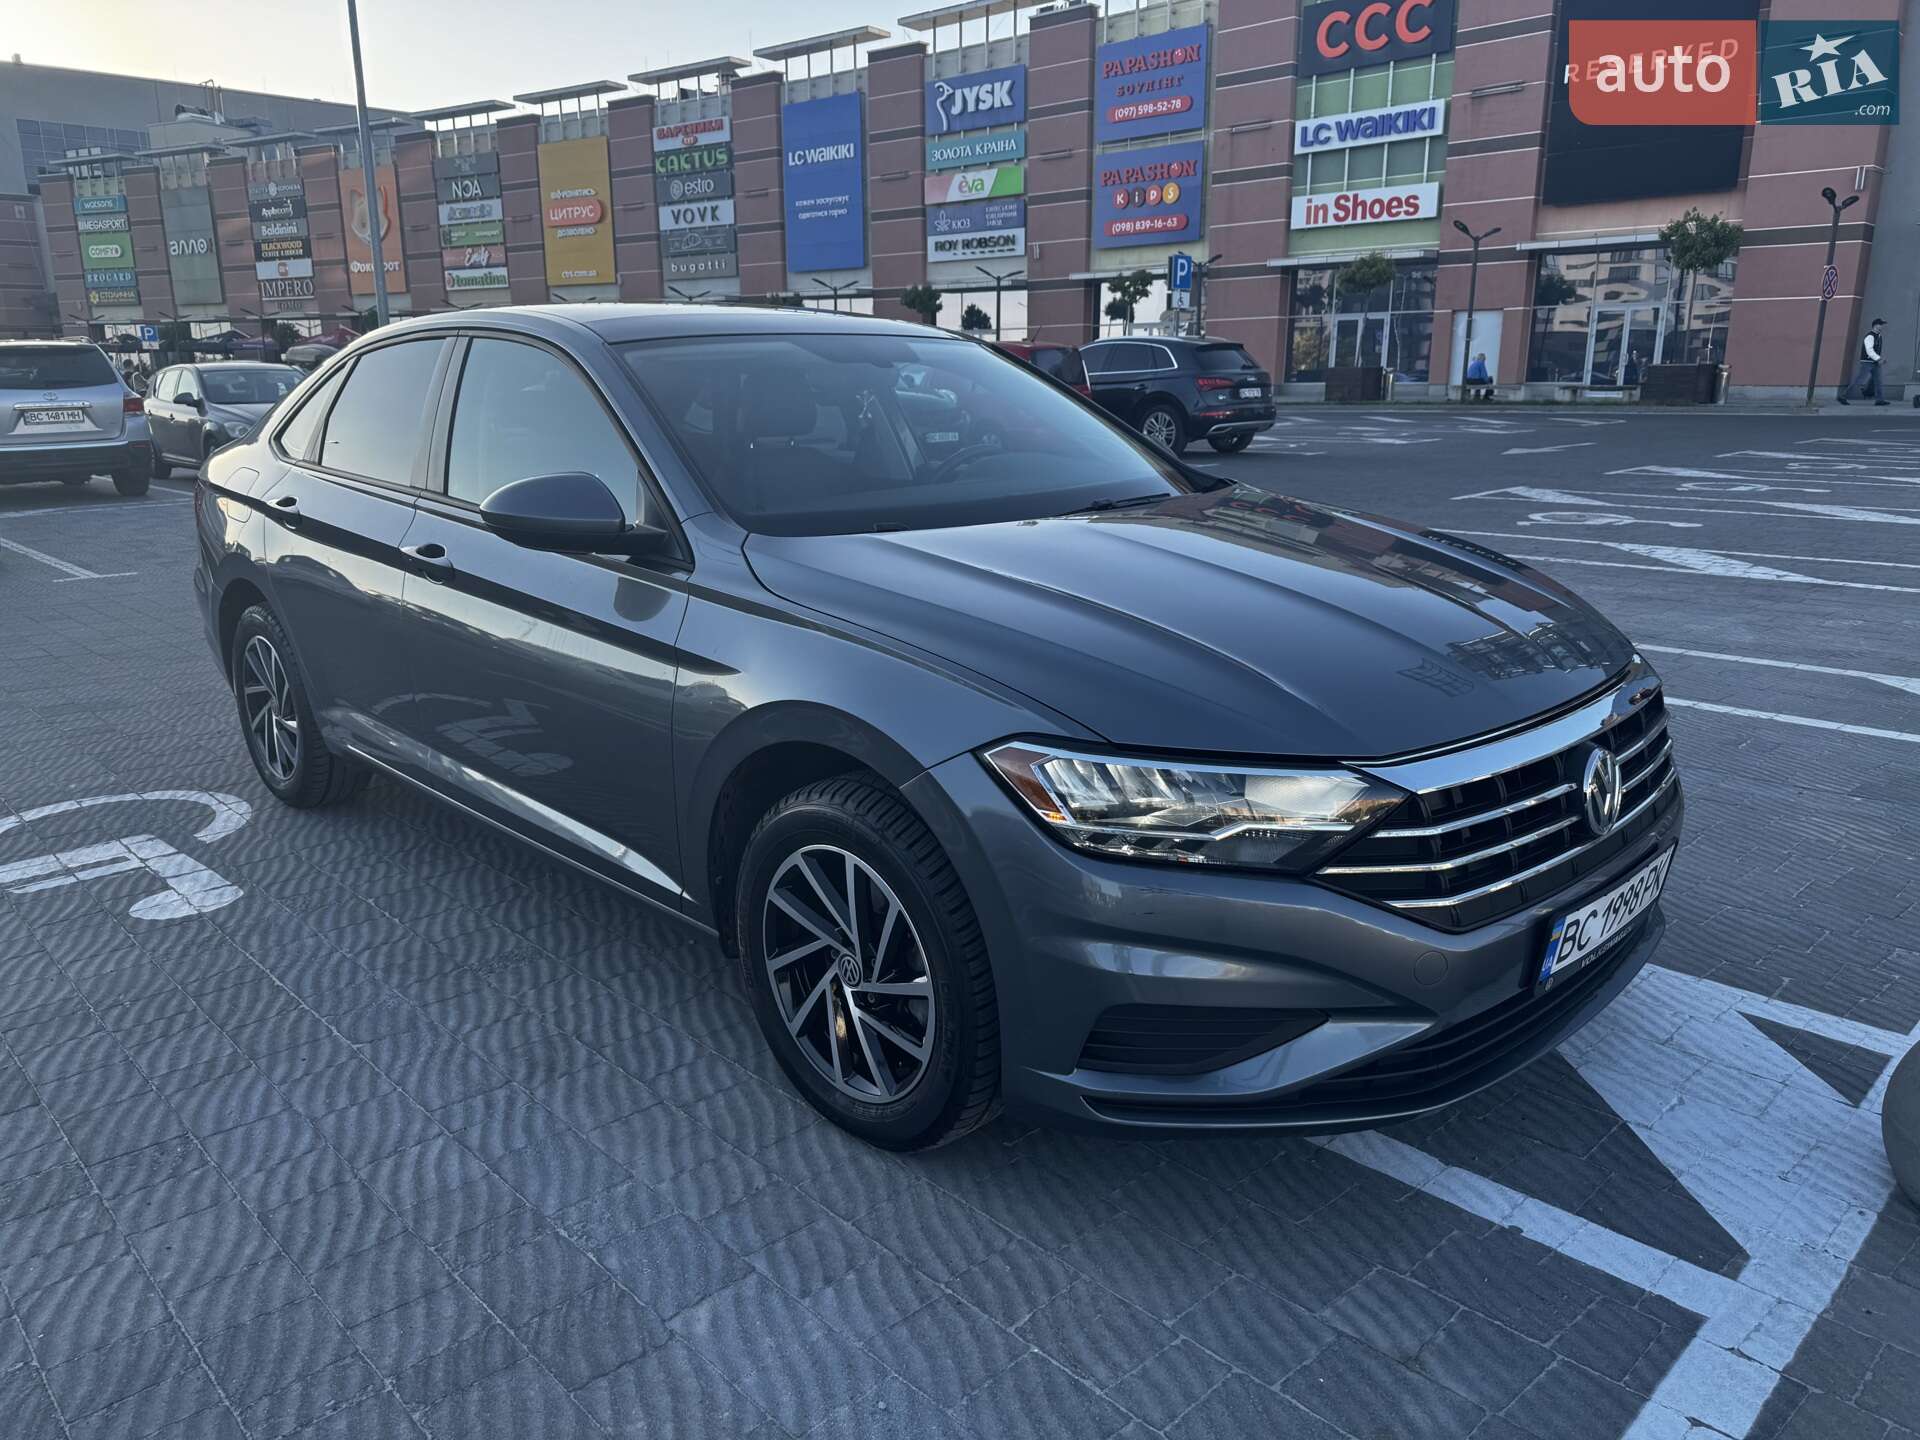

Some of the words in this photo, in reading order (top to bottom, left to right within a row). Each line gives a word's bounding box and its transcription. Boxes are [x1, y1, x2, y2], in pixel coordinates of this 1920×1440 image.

[1316, 0, 1432, 58] CCC
[1103, 44, 1201, 79] PAPASHON
[951, 79, 1014, 115] JYSK
[1115, 107, 1136, 121] (097)
[1300, 123, 1332, 148] LC
[788, 151, 805, 167] LC
[931, 145, 972, 162] ЗОЛОТА
[1101, 159, 1198, 188] PAPASHON
[550, 205, 595, 221] ЦИТРУС
[671, 204, 720, 225] VOVK
[1305, 198, 1329, 226] in
[1333, 193, 1421, 223] Shoes
[935, 241, 958, 252] ROY
[961, 234, 1016, 250] ROBSON
[671, 259, 726, 273] bugatti
[1176, 259, 1188, 285] P
[87, 273, 131, 282] BROCARD
[261, 280, 313, 297] IMPERO
[144, 327, 153, 340] P
[1556, 909, 1598, 965] BC
[1600, 874, 1645, 938] 1998
